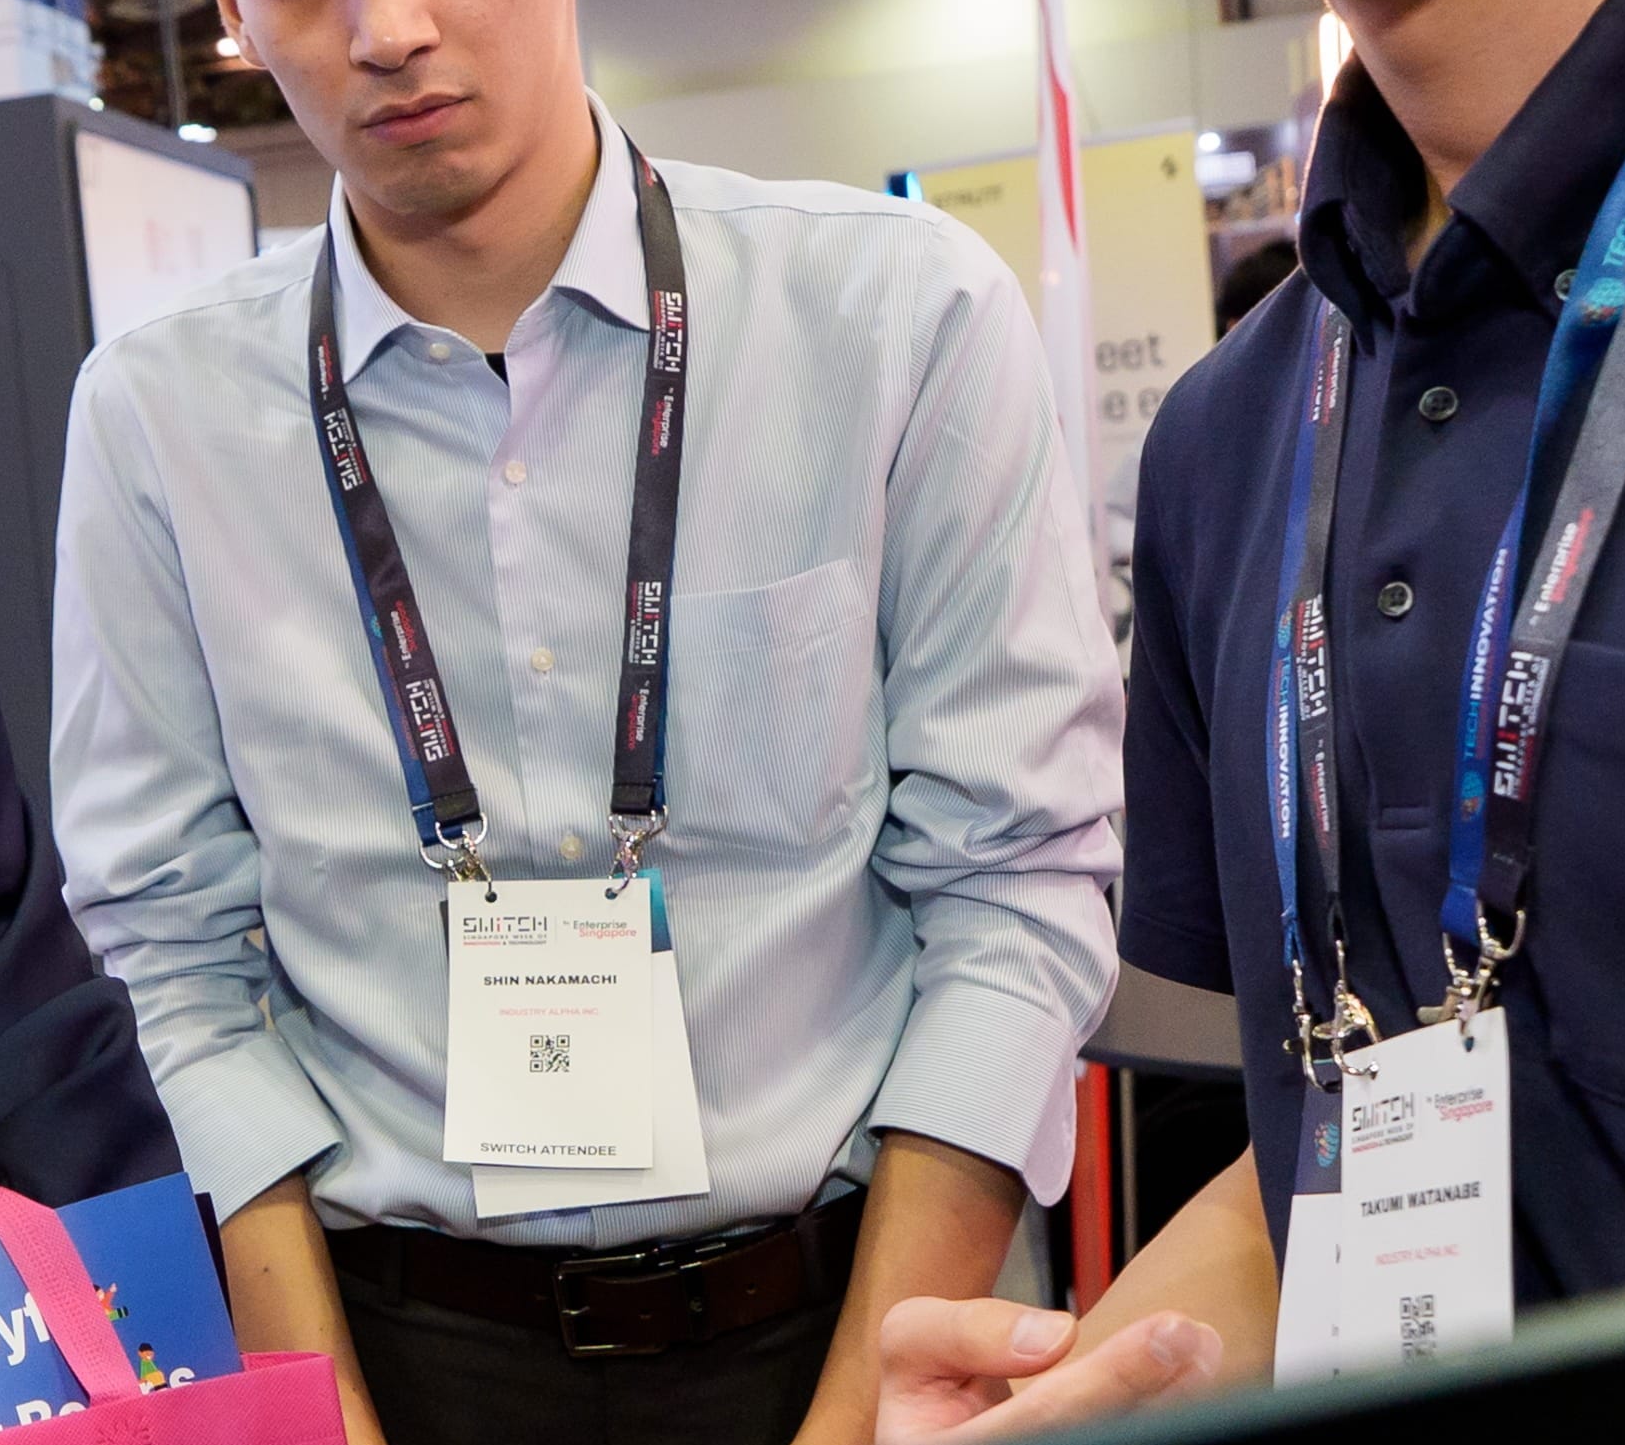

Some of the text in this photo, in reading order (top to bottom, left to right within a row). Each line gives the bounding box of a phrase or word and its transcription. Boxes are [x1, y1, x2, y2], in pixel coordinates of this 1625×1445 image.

[572, 919, 628, 932] Enterprise
[578, 927, 638, 940] Singapore
[483, 974, 618, 986] SHIN NAKAMACHI
[480, 1142, 617, 1157] SWITCH ATTENDEE
[1361, 1180, 1481, 1219] TAKUMI WATANABE
